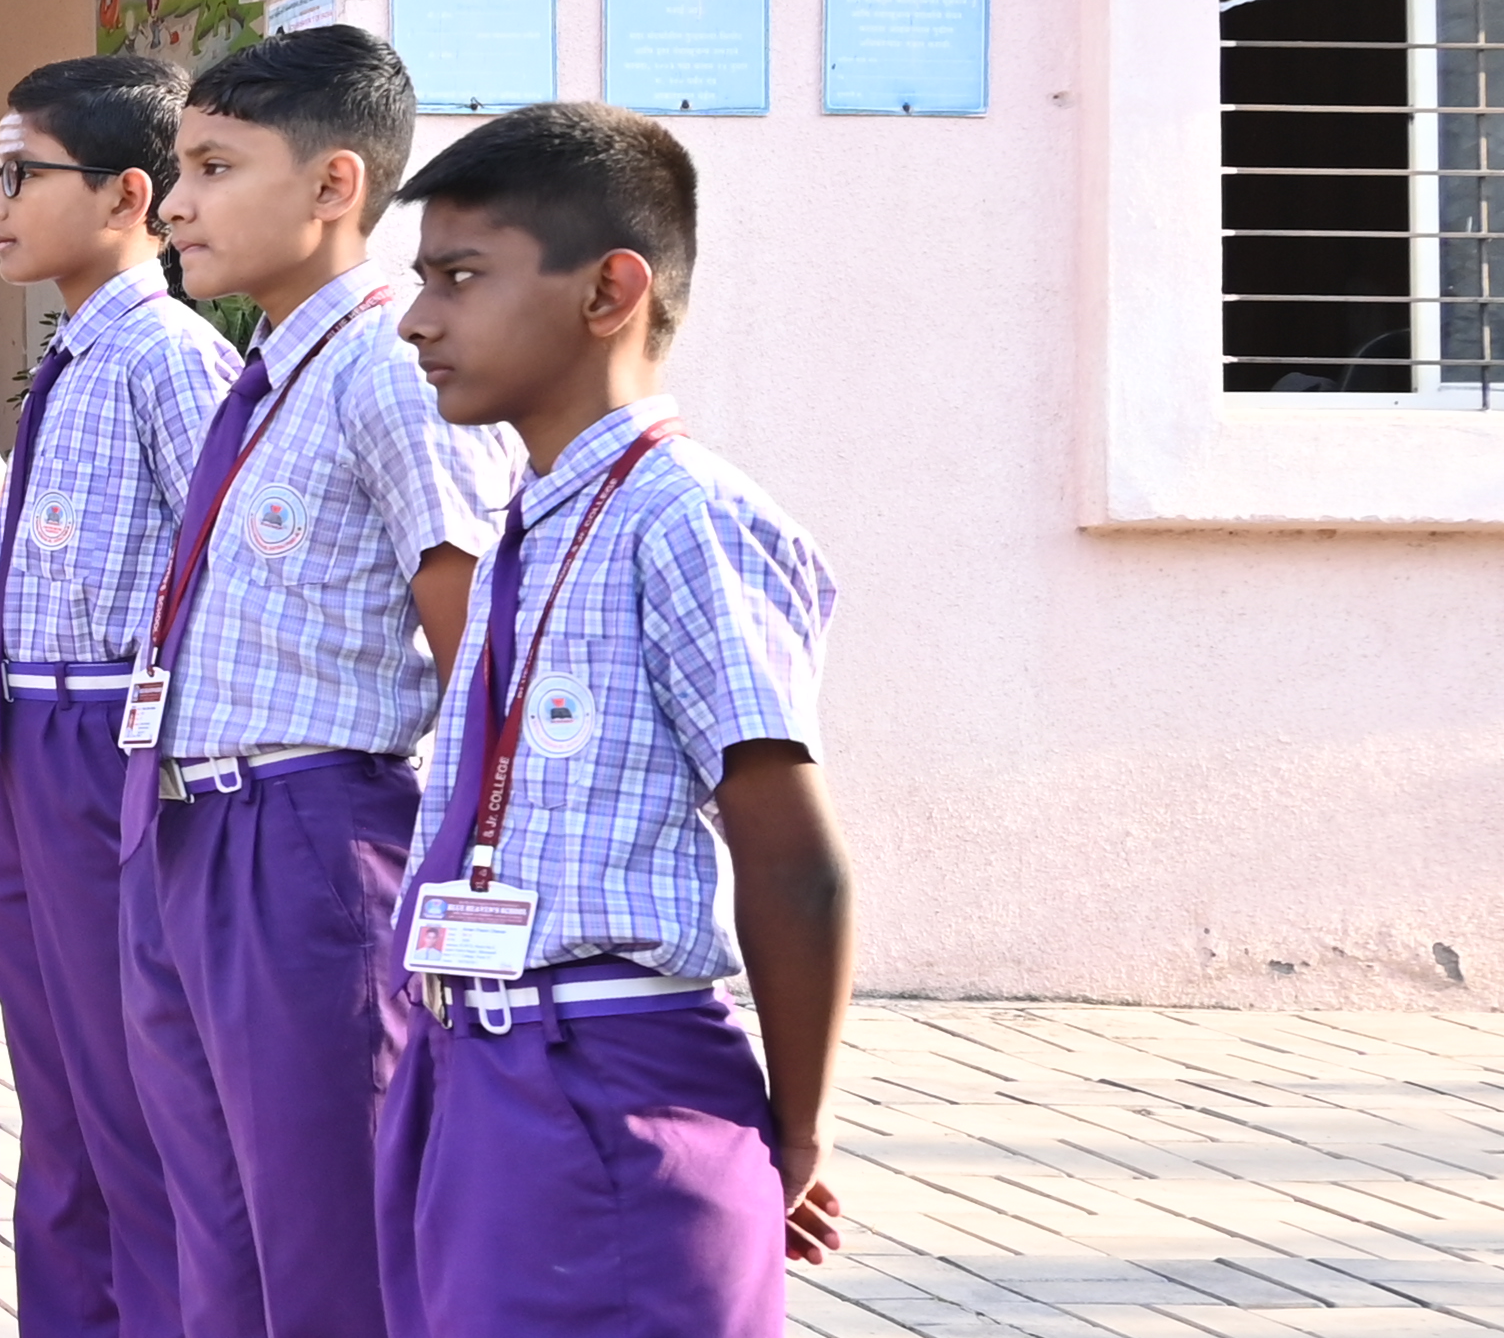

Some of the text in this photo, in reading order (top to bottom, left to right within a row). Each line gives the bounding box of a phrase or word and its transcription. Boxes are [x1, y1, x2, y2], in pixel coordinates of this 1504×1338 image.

[483, 756, 510, 838] & Jr. COLLEGE
